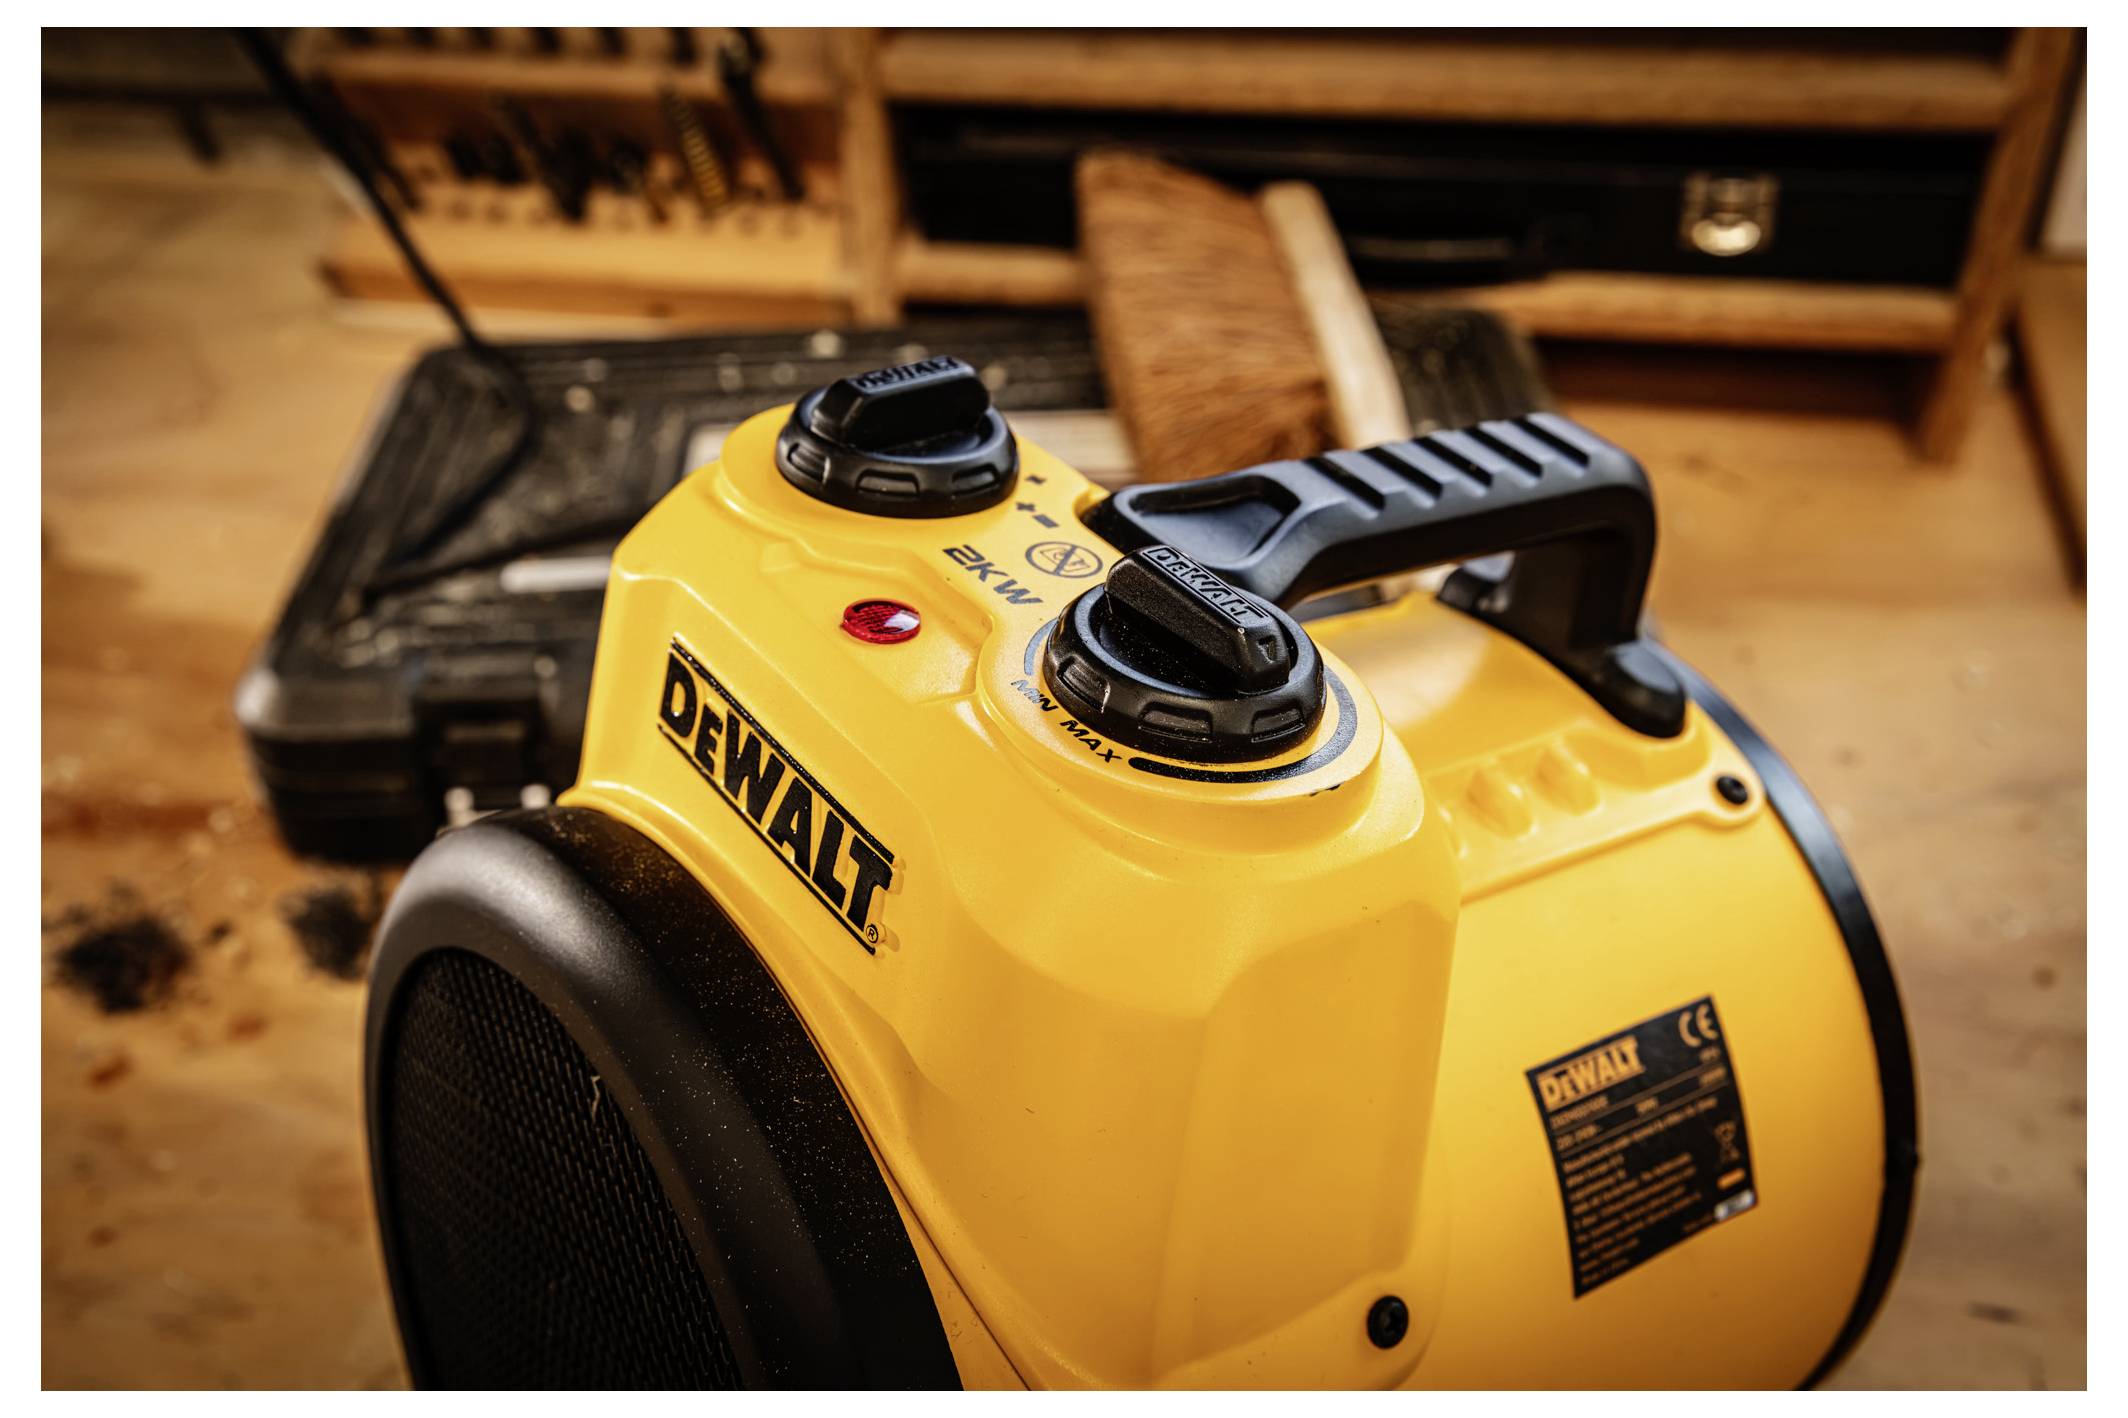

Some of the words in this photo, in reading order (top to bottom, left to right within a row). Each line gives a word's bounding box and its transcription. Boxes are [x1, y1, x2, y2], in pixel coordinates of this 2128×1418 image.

[1146, 547, 1268, 626] DEWALT
[1010, 679, 1059, 712] MIN
[1059, 719, 1122, 763] MAX
[1538, 1036, 1644, 1111] DEWALT
